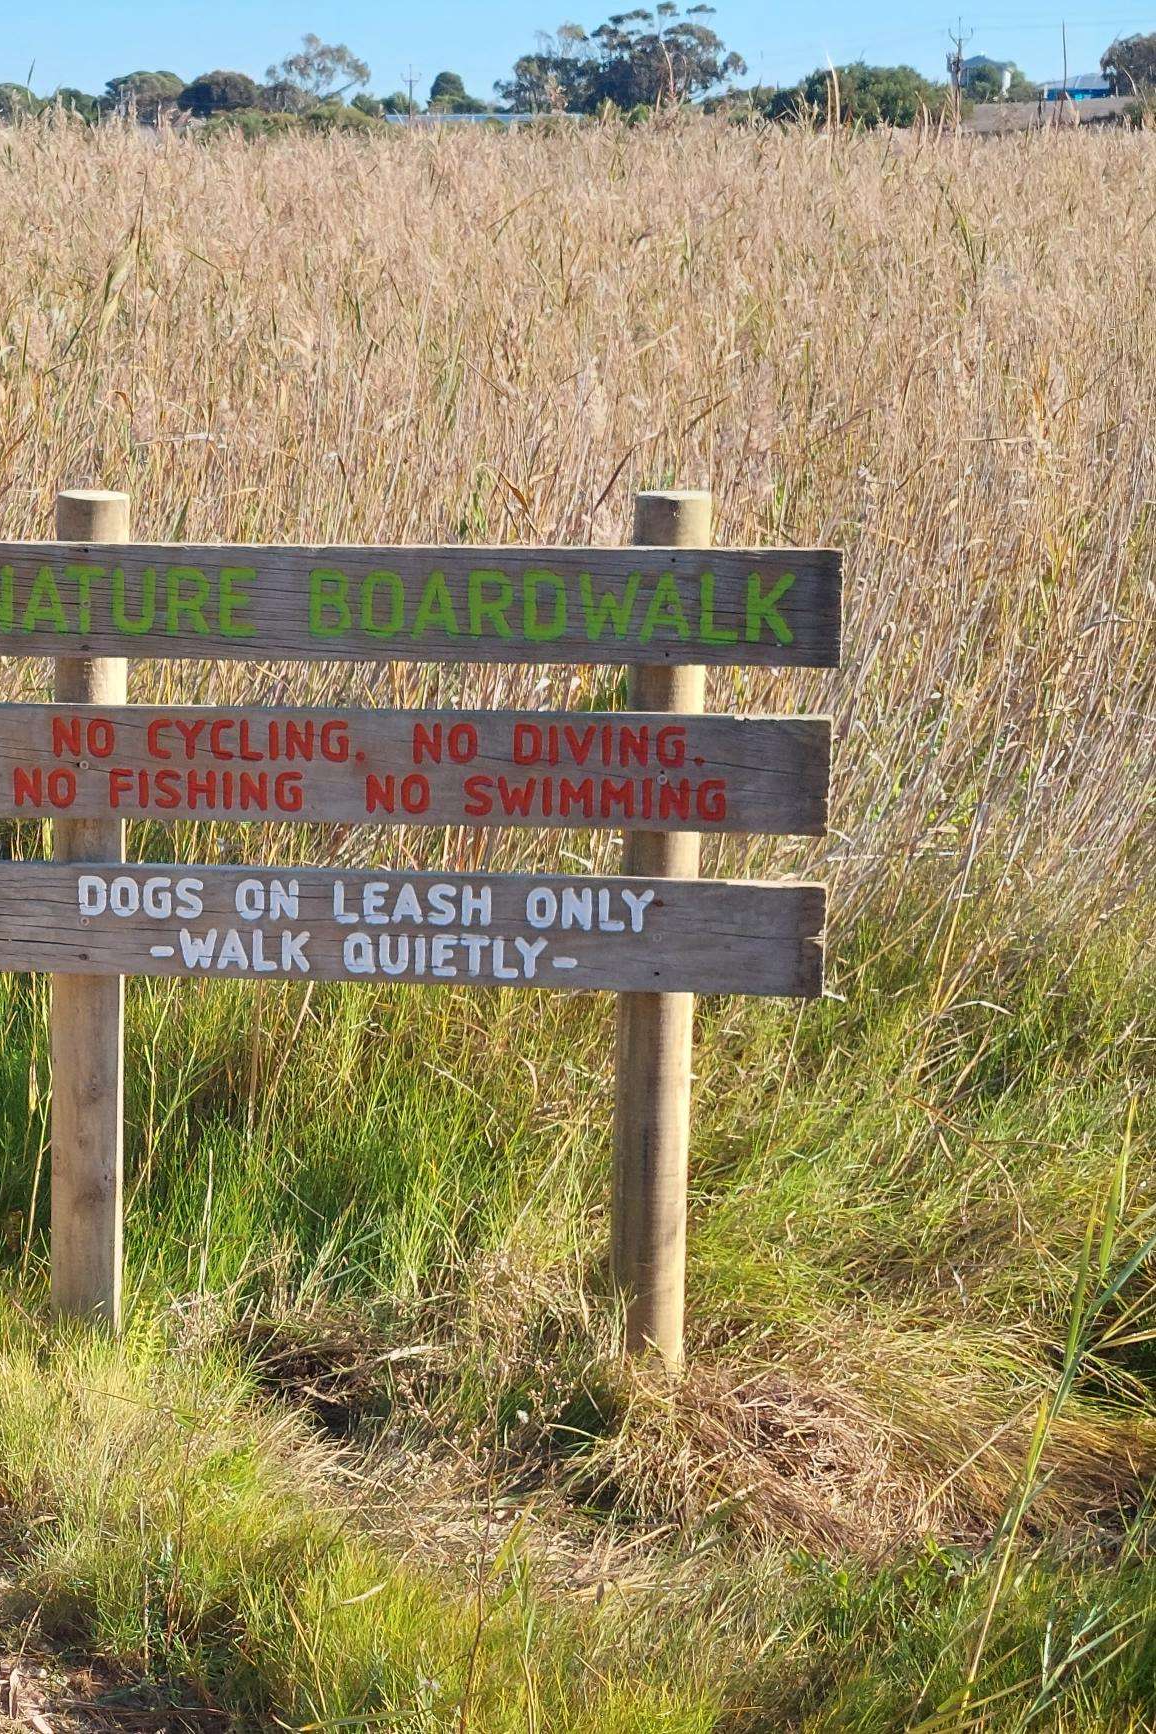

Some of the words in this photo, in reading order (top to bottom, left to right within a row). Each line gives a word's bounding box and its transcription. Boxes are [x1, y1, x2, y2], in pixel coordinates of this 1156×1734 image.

[309, 569, 796, 645] BOARDWALK
[52, 714, 115, 758] NO
[413, 722, 478, 765] NO
[12, 766, 77, 809] NO
[109, 768, 304, 812] FISHING
[366, 772, 431, 815] NO
[464, 774, 727, 823] SWIMMING
[78, 875, 204, 920] DOGS
[235, 878, 300, 921] ON
[333, 880, 492, 927] LEASH
[526, 886, 655, 934] ONLY
[150, 927, 310, 973] -WALK
[343, 932, 578, 980] QUIETLY-
